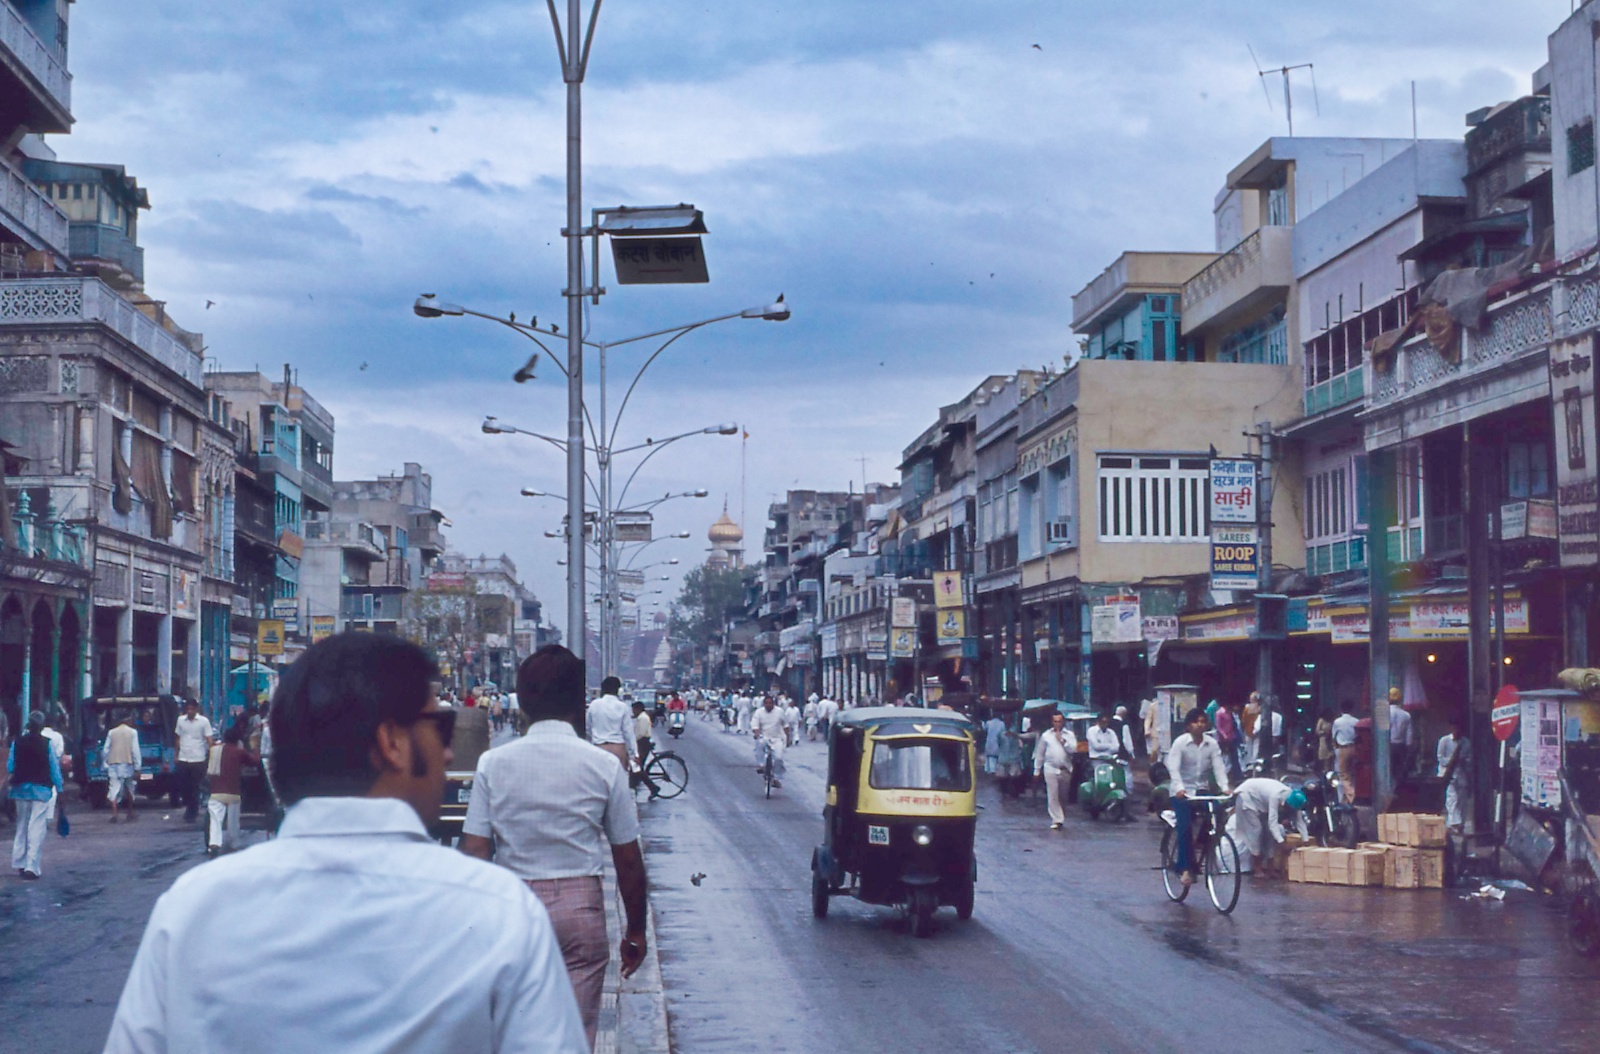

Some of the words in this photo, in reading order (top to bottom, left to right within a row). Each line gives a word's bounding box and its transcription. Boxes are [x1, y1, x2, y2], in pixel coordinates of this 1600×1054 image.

[1214, 486, 1252, 509] साड़ी
[1219, 532, 1250, 543] SAREES
[1214, 546, 1255, 561] ROOP
